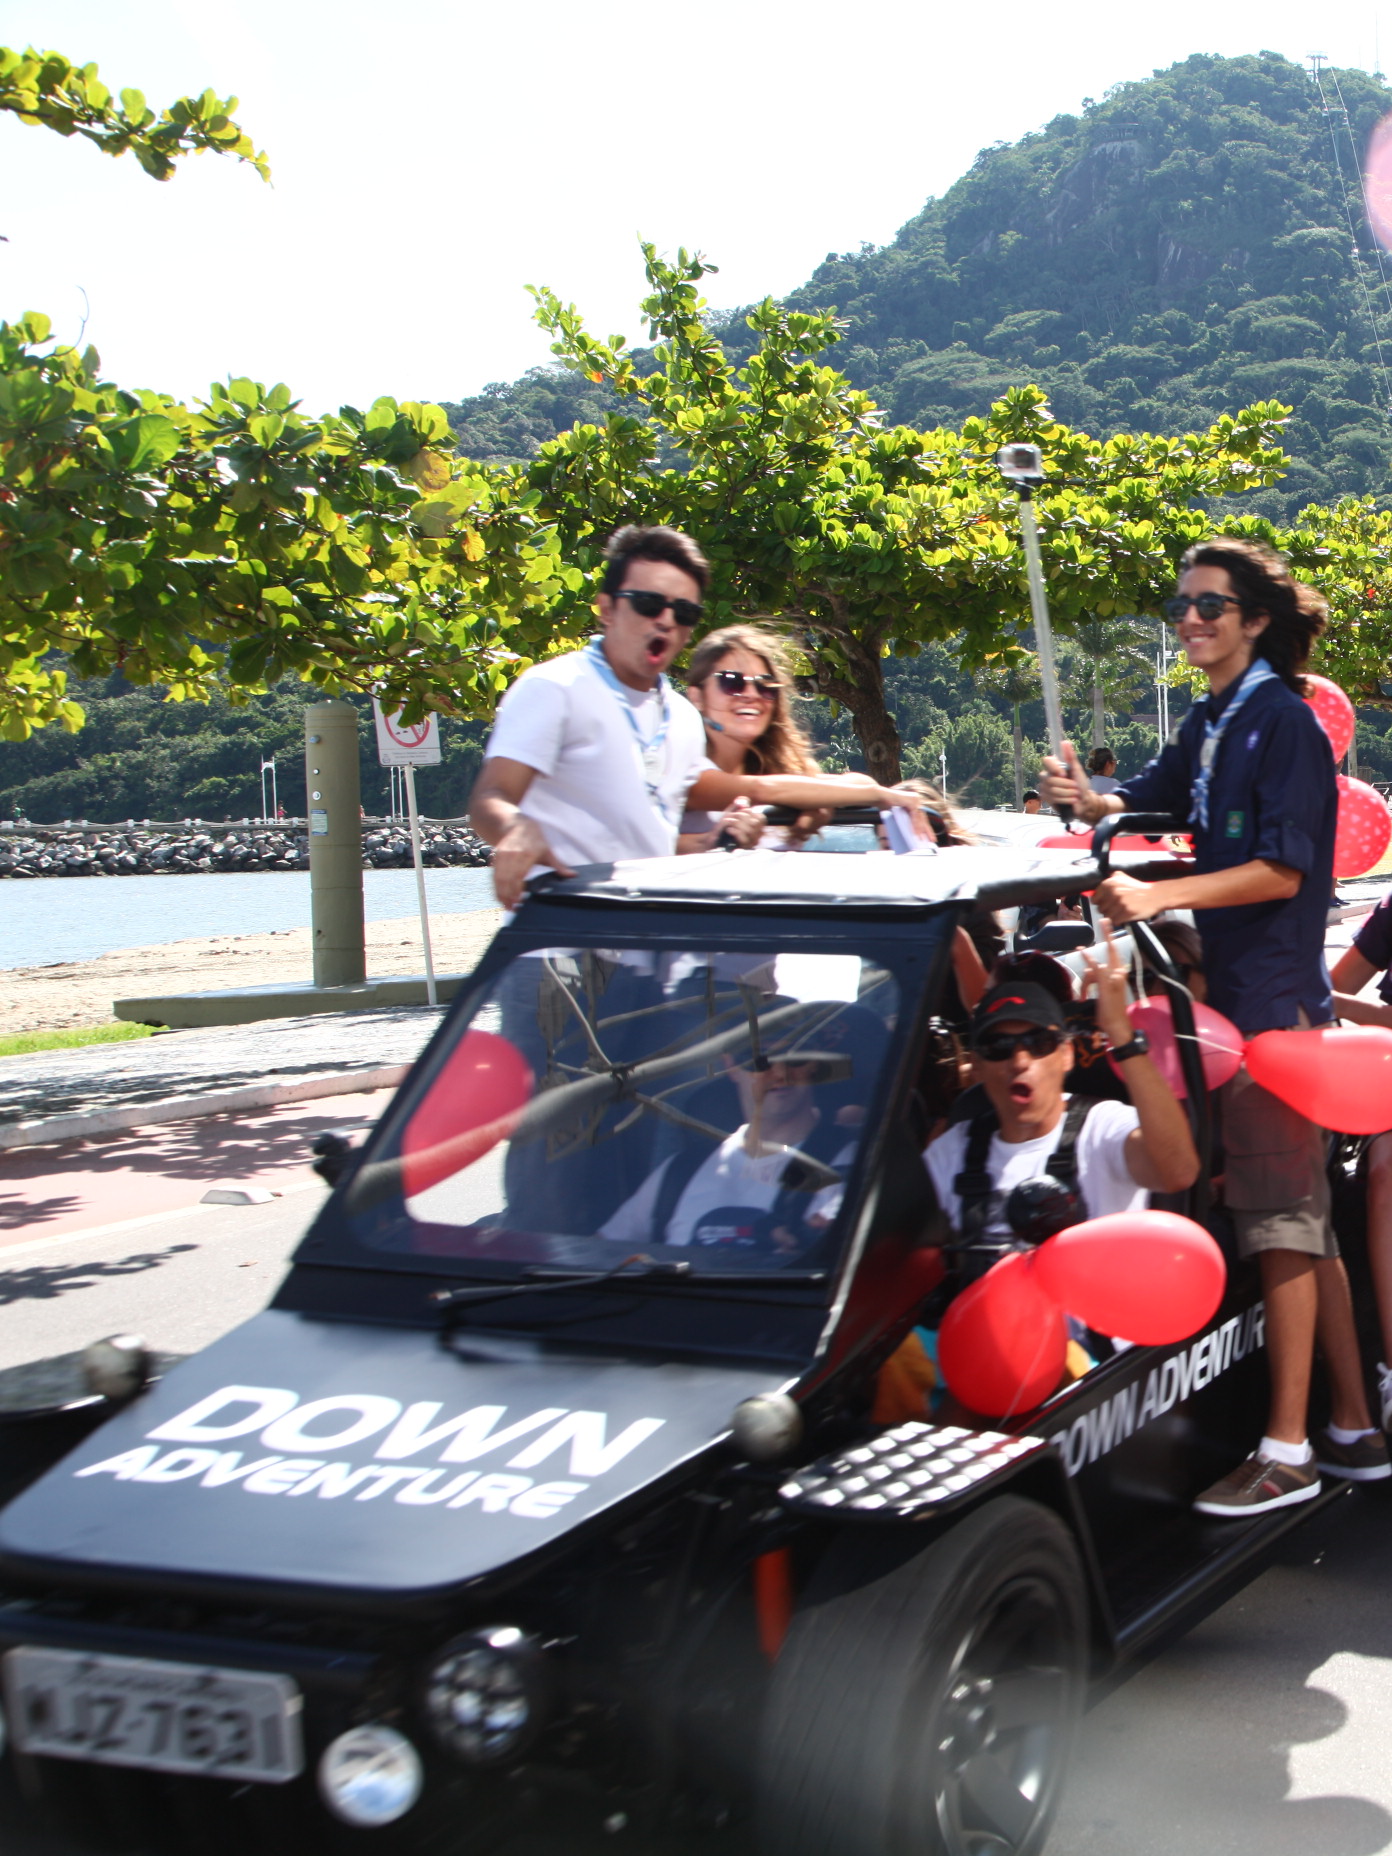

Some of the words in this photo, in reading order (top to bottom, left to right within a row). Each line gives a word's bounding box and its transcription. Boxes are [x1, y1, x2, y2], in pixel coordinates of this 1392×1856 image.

[1136, 1299, 1266, 1430] ADVENTUR
[145, 1384, 667, 1478] DOWN
[73, 1444, 591, 1519] ADVENTURE
